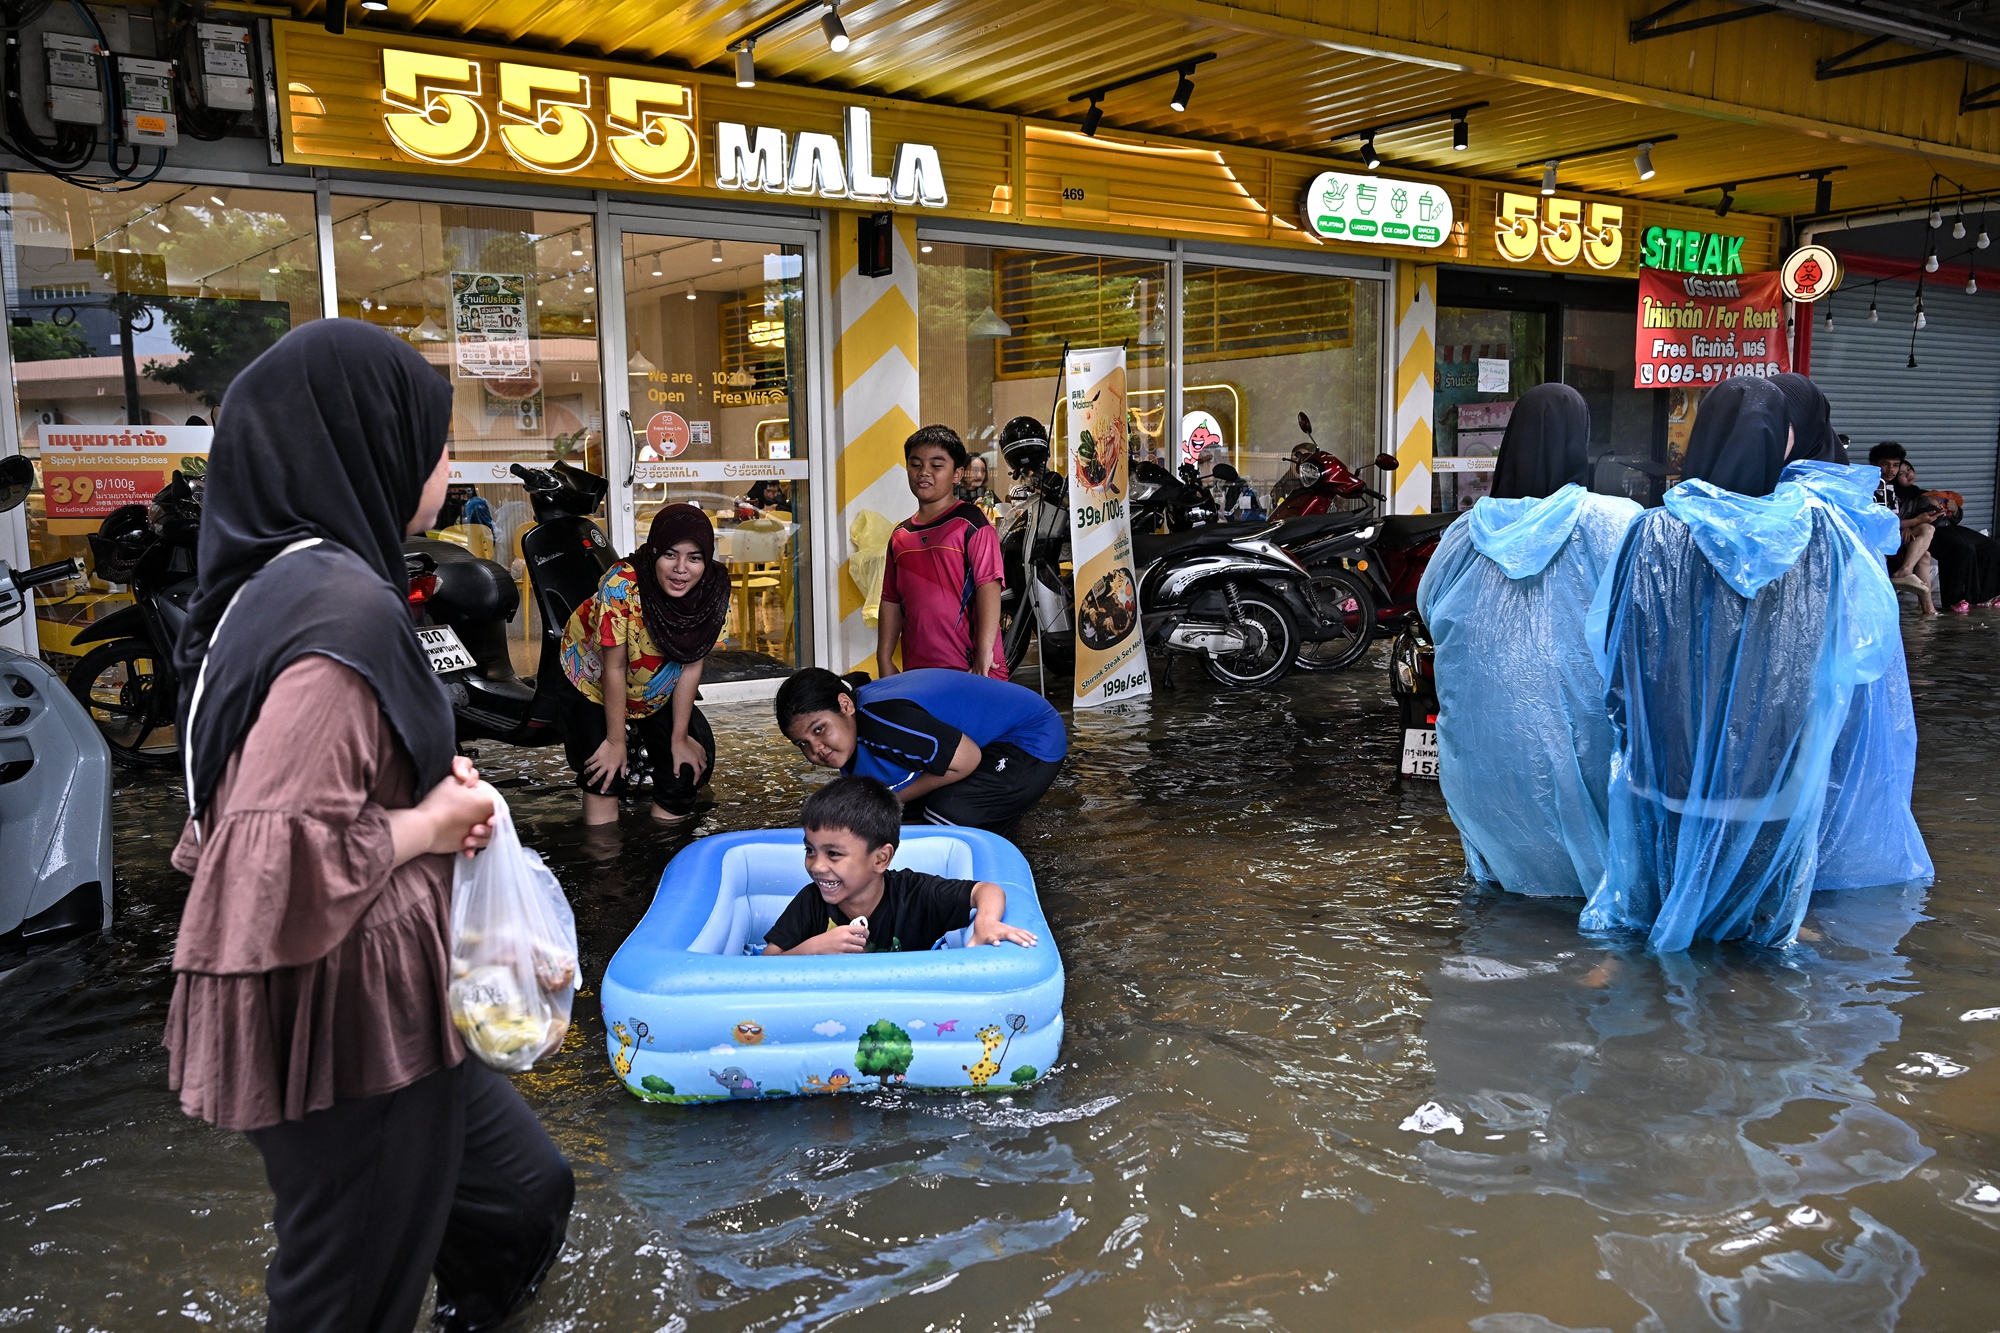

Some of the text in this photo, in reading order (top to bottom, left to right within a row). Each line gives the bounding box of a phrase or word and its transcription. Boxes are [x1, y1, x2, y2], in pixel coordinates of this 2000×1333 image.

[379, 48, 699, 183] 555
[714, 106, 949, 209] MALA
[1062, 188, 1085, 200] 469
[1495, 191, 1624, 270] 555
[1640, 226, 1746, 275] STEAK
[1683, 276, 1741, 298] ประกาศ
[498, 314, 522, 328] 10%
[1642, 296, 1703, 329] ให้เช่าตึก
[1715, 305, 1741, 329] For
[1743, 306, 1779, 329] Rent
[1652, 339, 1687, 358] Free
[1742, 337, 1766, 357] แอร์
[648, 369, 693, 384] We are
[712, 371, 747, 385] 10:30
[1445, 369, 1477, 387] ร้านนี้ร่ว
[1657, 362, 1781, 384] 095-9719856
[648, 388, 685, 405] Open
[713, 390, 769, 405] Free Wifi
[1072, 400, 1094, 410] Malatang
[48, 429, 168, 452] เมนูหมาล่าถัง
[50, 456, 168, 466] Spicy Hot Pot Soup Bases
[50, 476, 95, 504] 39
[55, 506, 84, 514] Excluding
[431, 654, 465, 672] 294
[1104, 655, 1121, 673] Steak
[1121, 647, 1132, 659] Set
[1132, 637, 1143, 650] Mea
